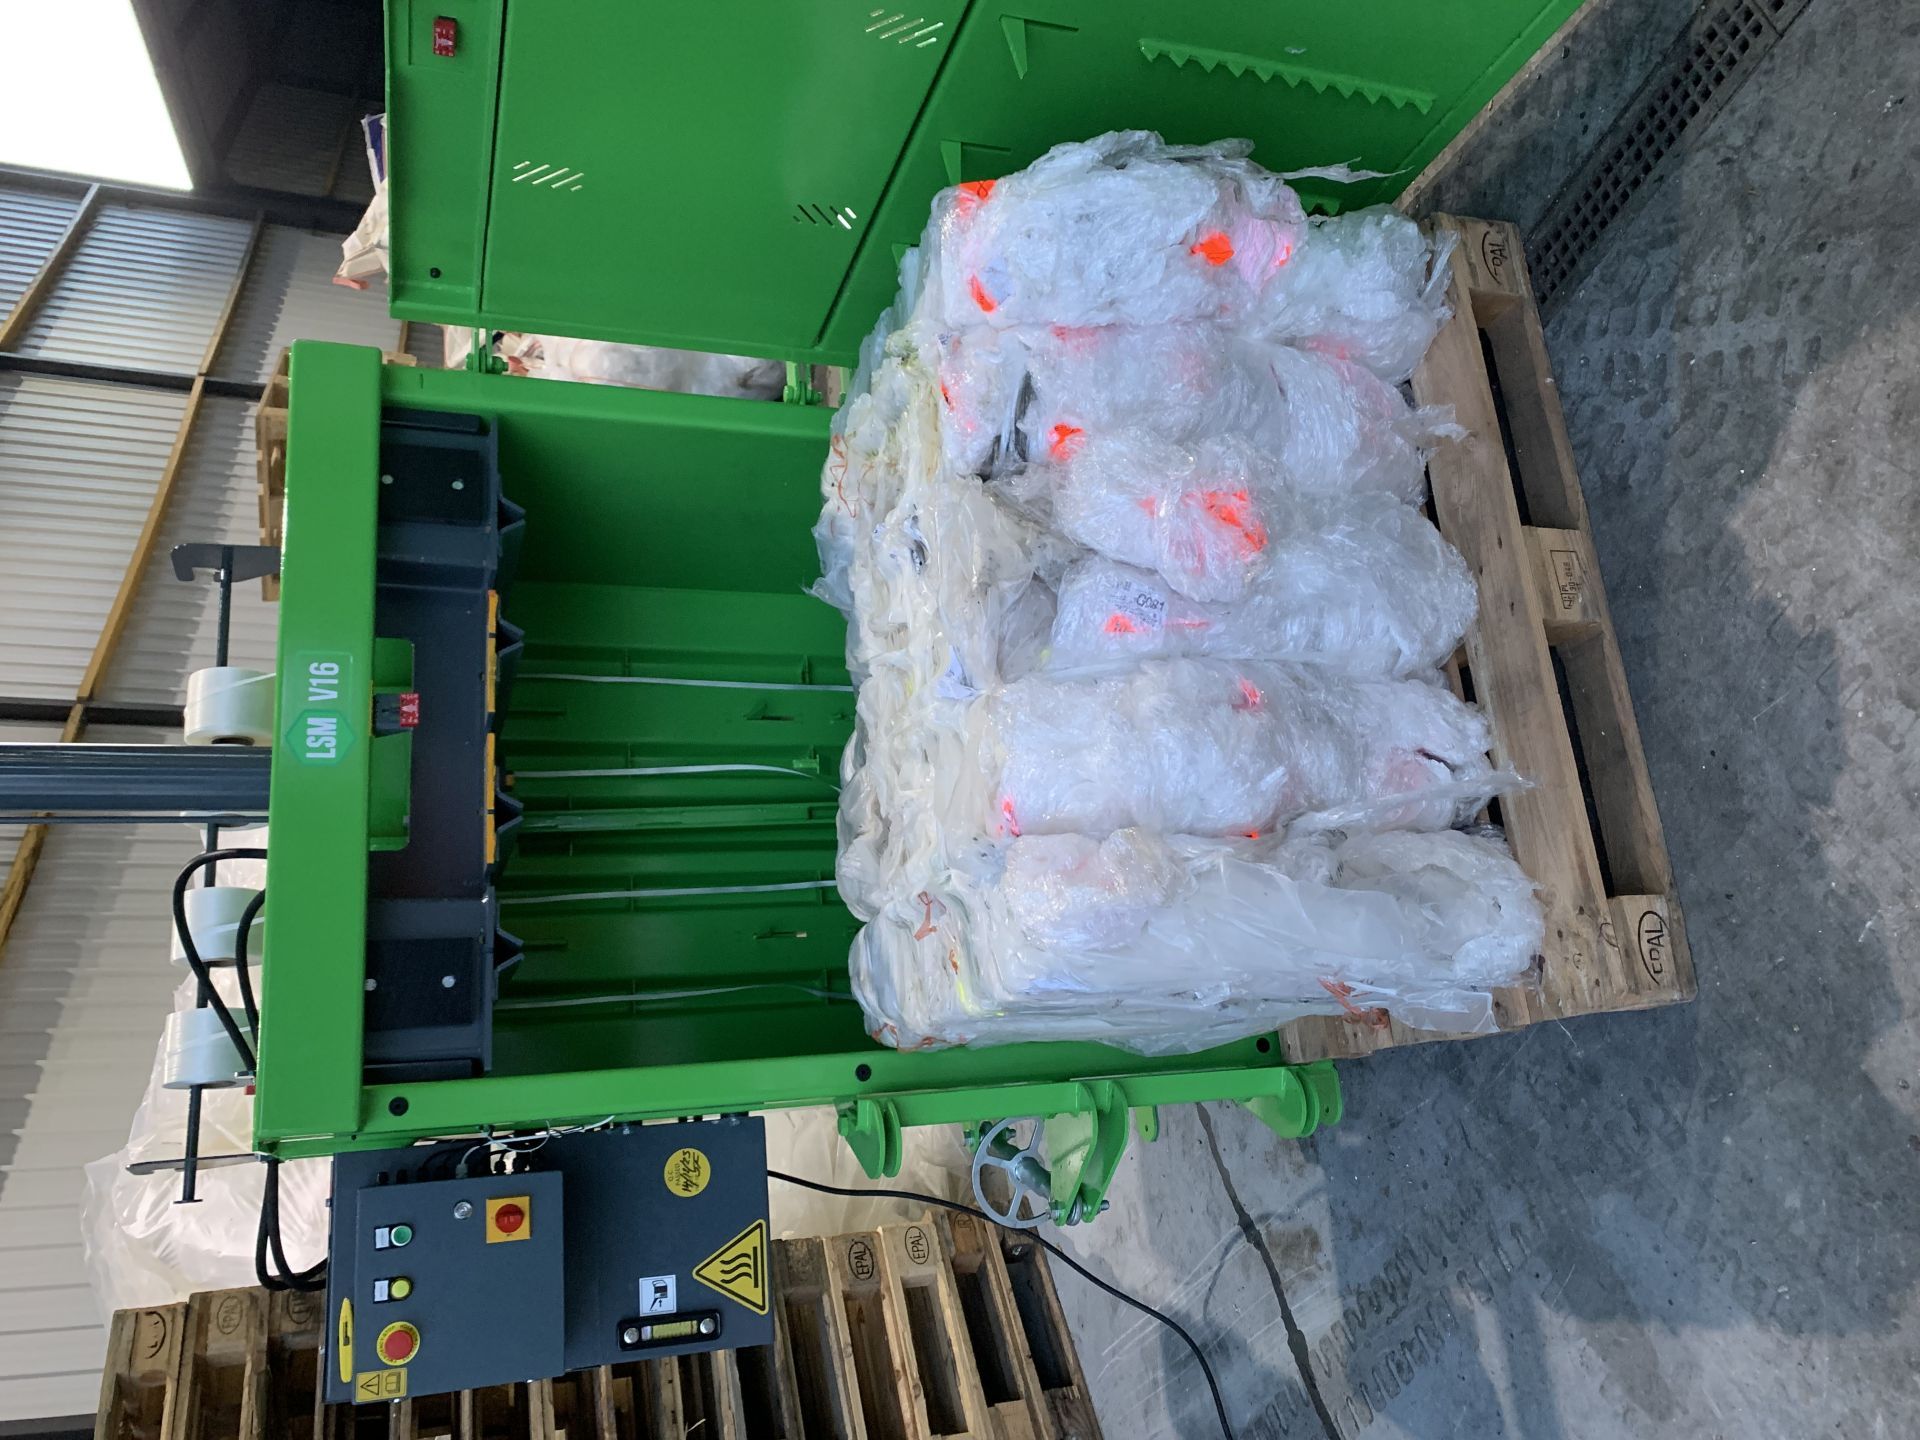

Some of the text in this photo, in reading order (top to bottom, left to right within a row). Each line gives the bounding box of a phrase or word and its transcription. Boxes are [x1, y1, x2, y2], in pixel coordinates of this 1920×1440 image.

[305, 661, 340, 759] LSM V16
[909, 1231, 926, 1260] EPAL
[853, 1247, 870, 1276] EPAL
